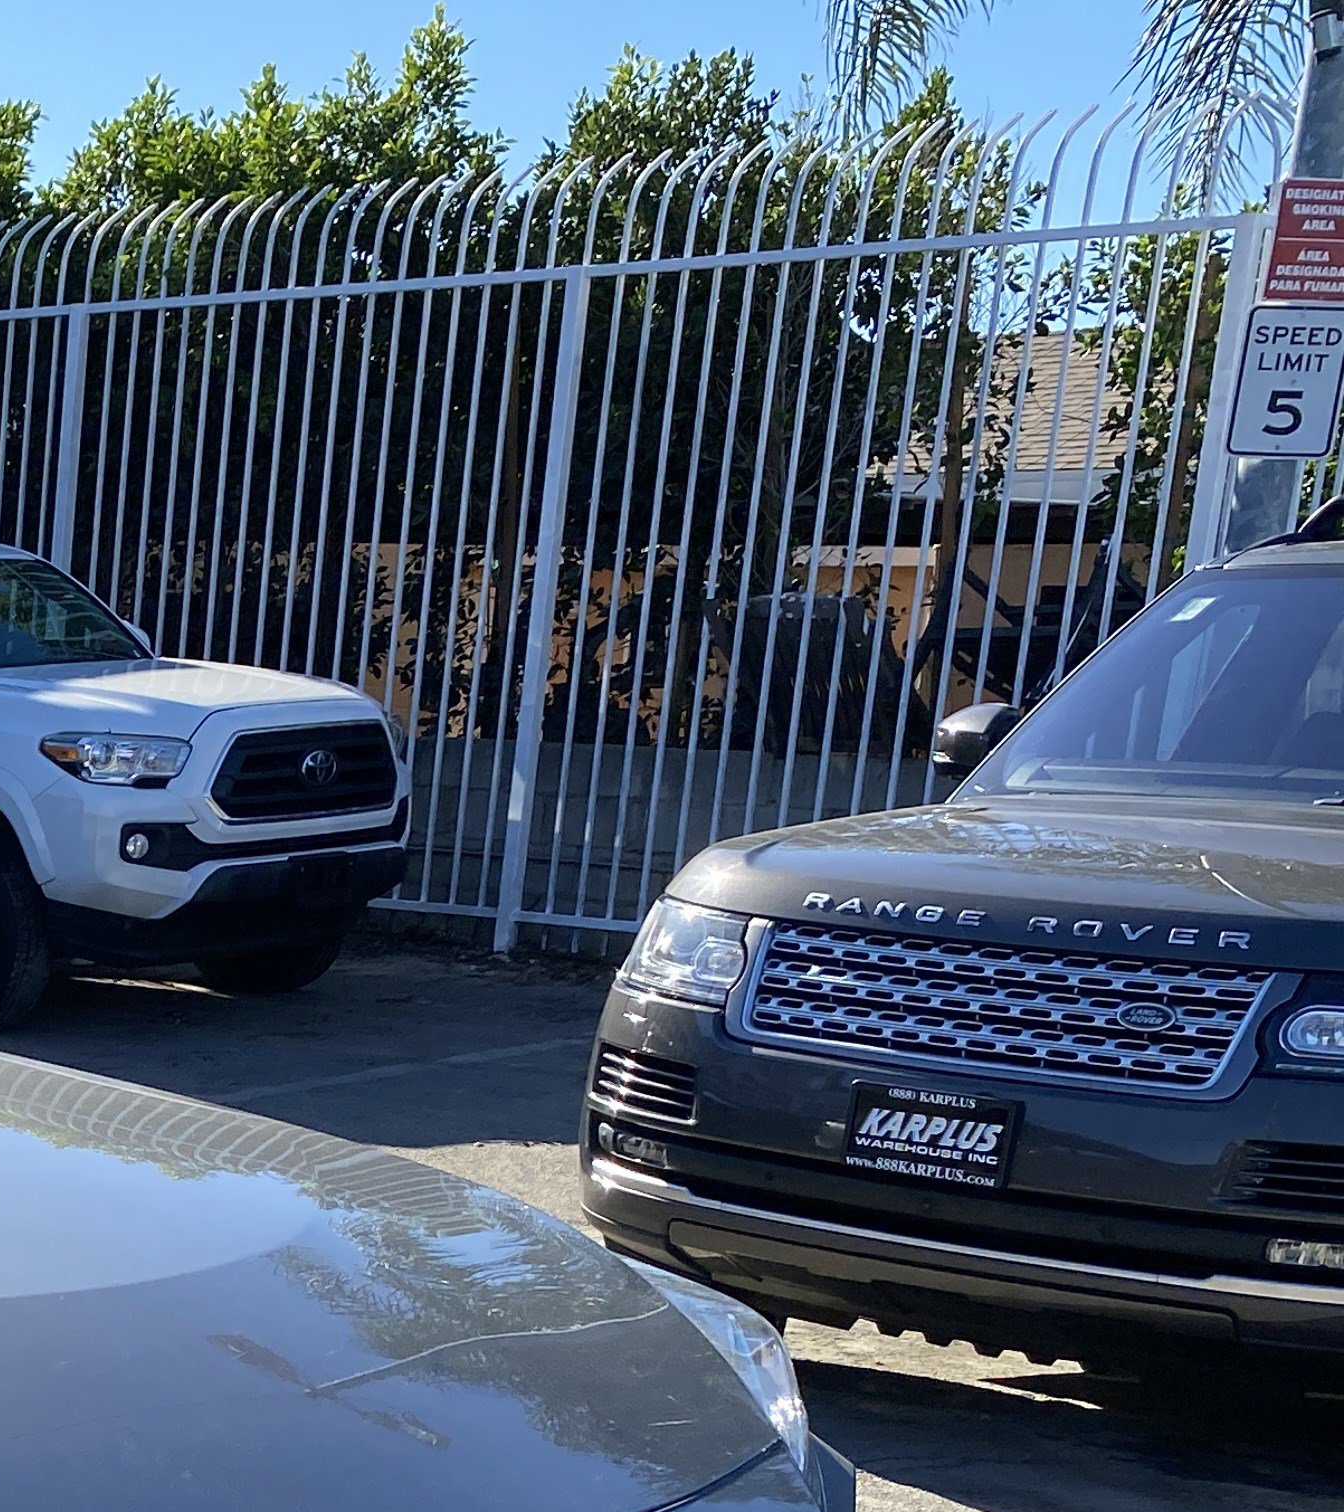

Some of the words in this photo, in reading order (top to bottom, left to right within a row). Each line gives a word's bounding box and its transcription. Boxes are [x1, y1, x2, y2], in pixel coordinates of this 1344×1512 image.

[1302, 219, 1336, 231] AREA
[1269, 279, 1301, 292] PARA
[1254, 325, 1343, 346] SPEED
[1257, 352, 1330, 373] LIMIT
[1262, 390, 1304, 435] 5
[802, 891, 987, 927] RANGE
[1026, 915, 1251, 950] ROVER
[888, 1087, 916, 1101] (888)
[919, 1091, 977, 1110] KARPLUS
[859, 1107, 1004, 1152] KARPLUS
[854, 1135, 963, 1161] WAREHOUSE
[968, 1152, 998, 1166] INC
